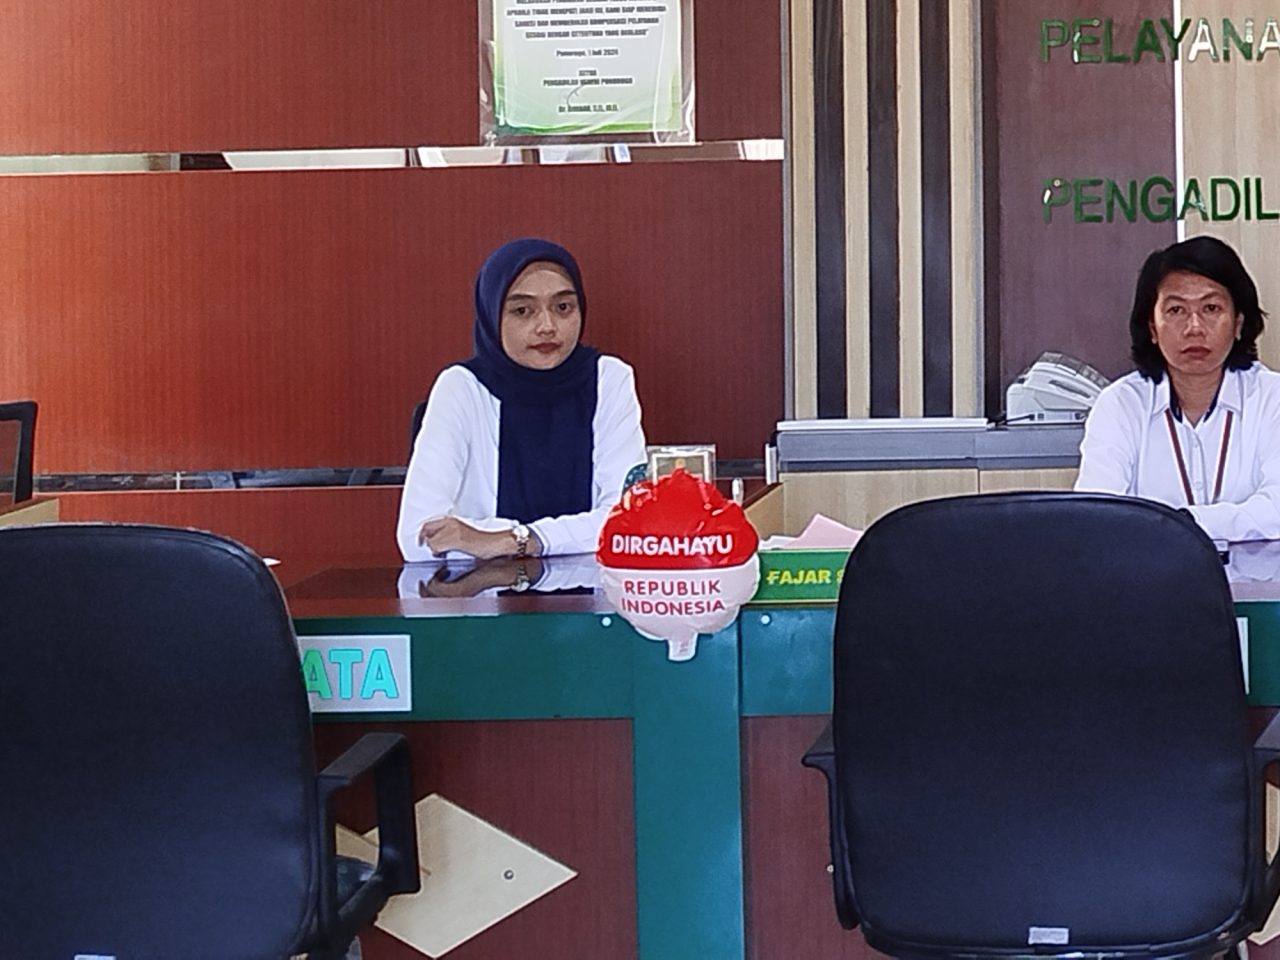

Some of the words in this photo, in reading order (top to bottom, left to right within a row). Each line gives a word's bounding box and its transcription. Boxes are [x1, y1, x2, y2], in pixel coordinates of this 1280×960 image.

[611, 533, 733, 557] DIRGAHAYU
[766, 569, 832, 586] FAJAR
[624, 579, 722, 597] REPUBLIK
[621, 598, 726, 617] INDONESIA
